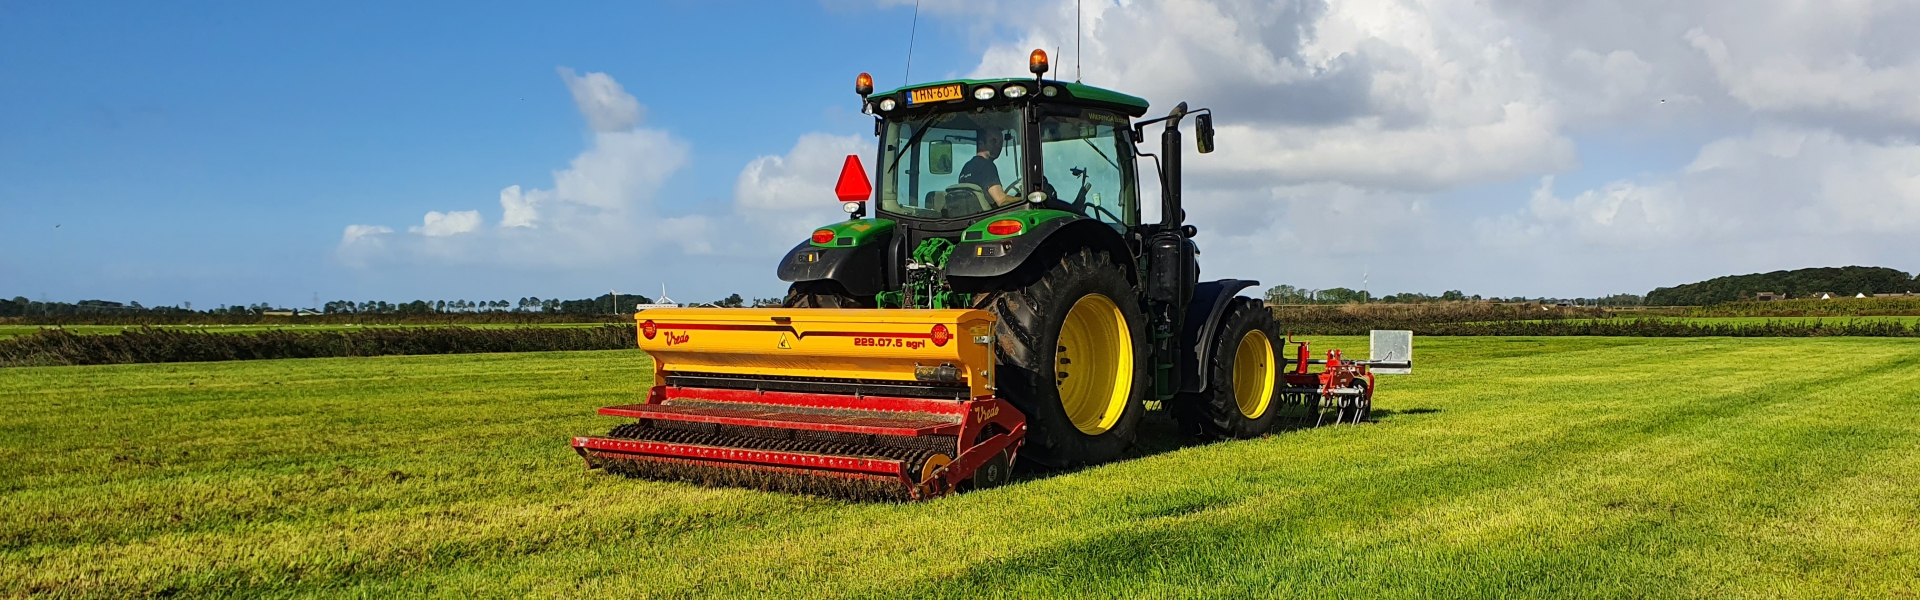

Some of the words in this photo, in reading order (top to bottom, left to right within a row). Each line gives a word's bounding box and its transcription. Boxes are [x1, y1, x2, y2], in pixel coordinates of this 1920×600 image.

[914, 85, 960, 101] THN-60-X
[663, 330, 690, 347] Vredo
[906, 339, 925, 350] agri
[974, 402, 1000, 424] Vredo
